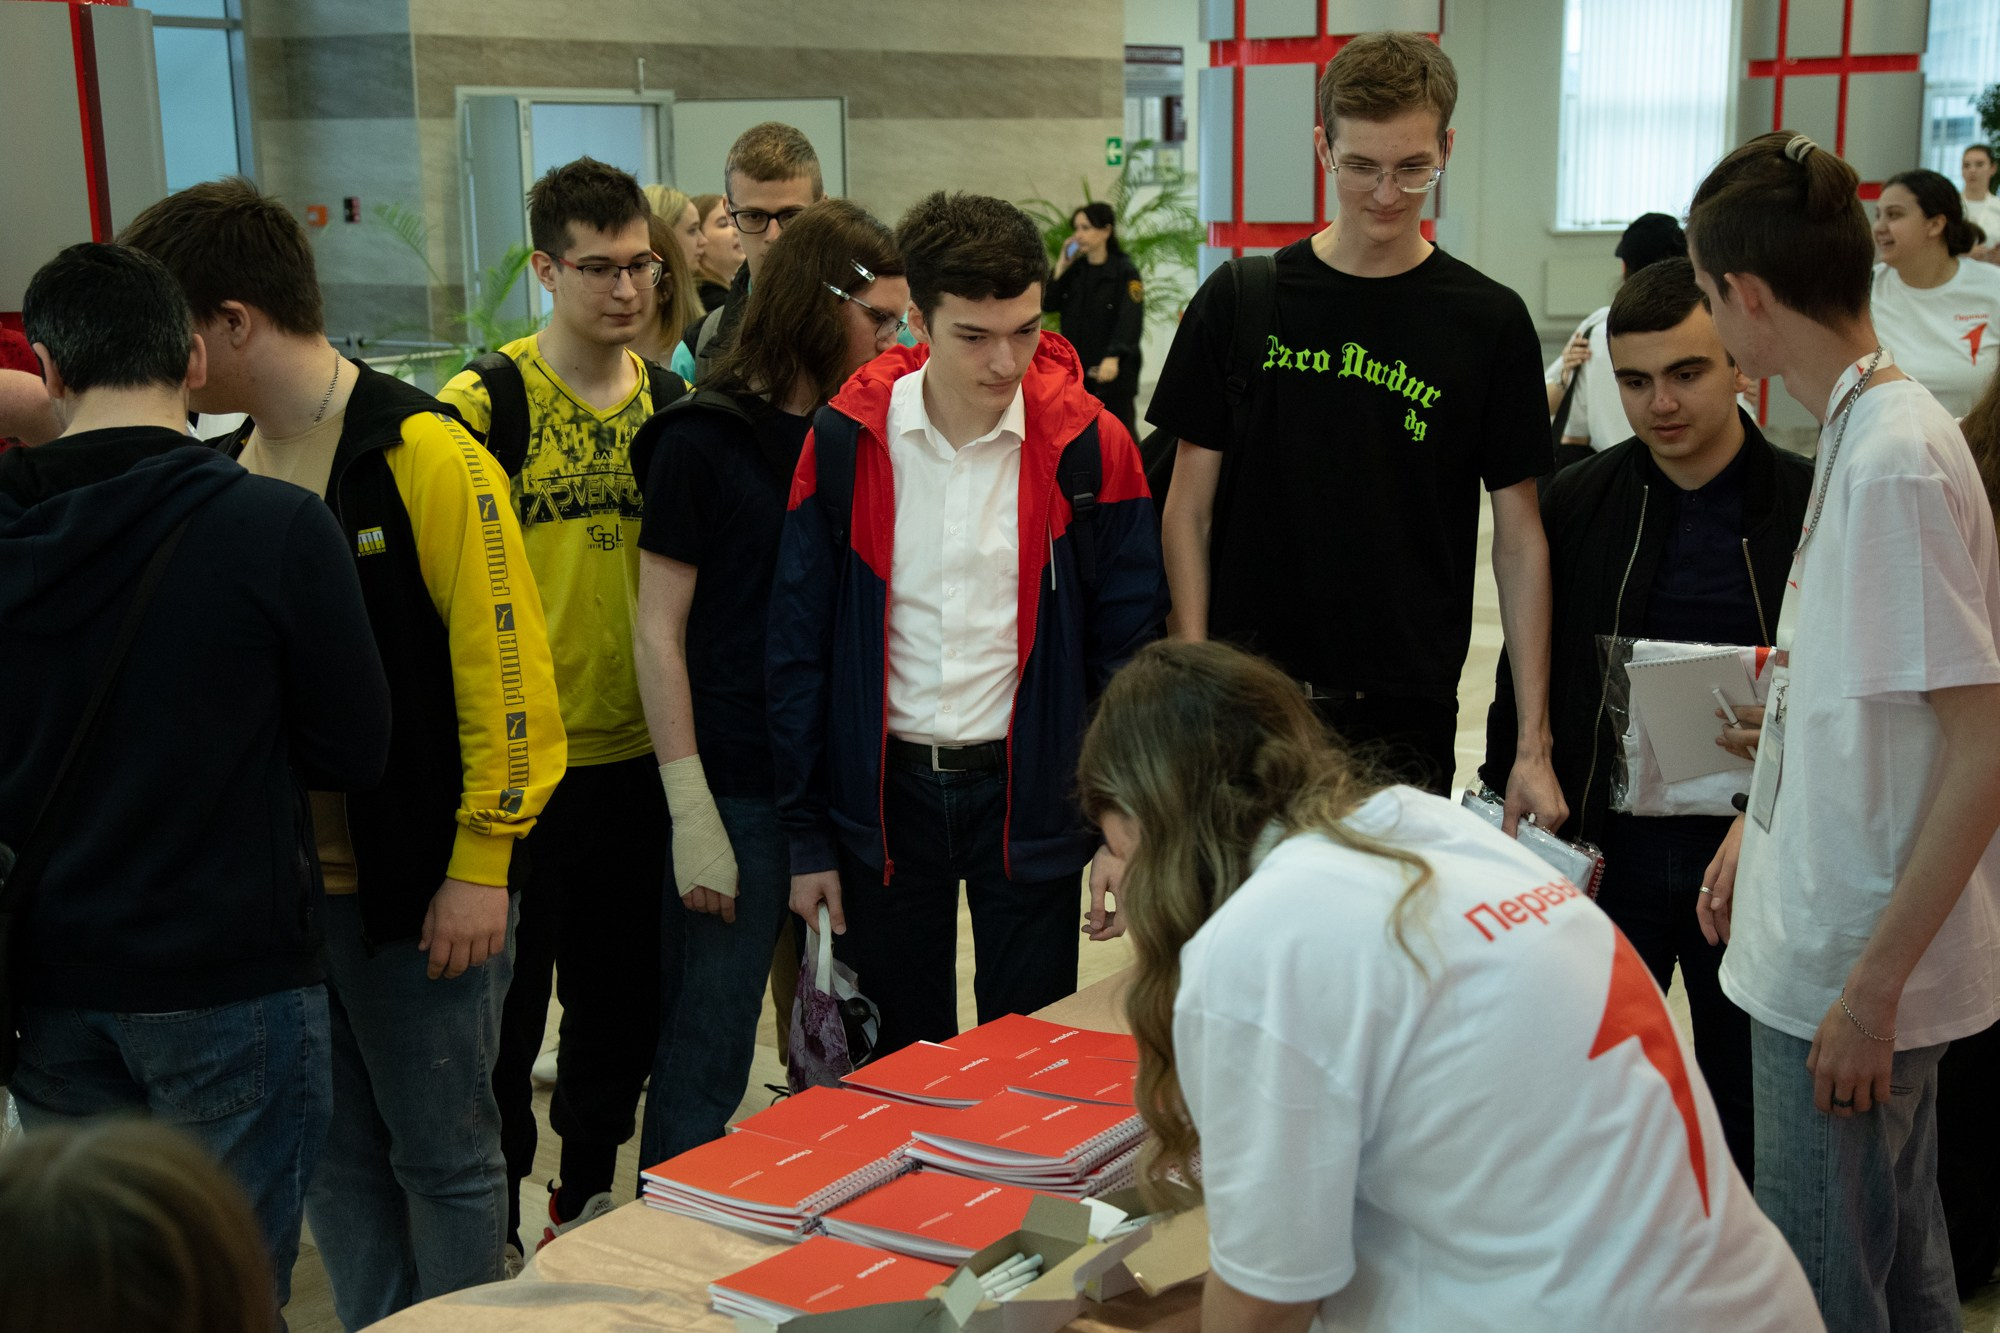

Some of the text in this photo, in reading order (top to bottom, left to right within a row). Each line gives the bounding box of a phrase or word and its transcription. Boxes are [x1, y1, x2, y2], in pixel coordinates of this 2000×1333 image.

[443, 424, 490, 488] PUMA
[482, 523, 511, 597] PUMA
[497, 633, 525, 706] PUMA
[1463, 876, 1581, 942] Первы
